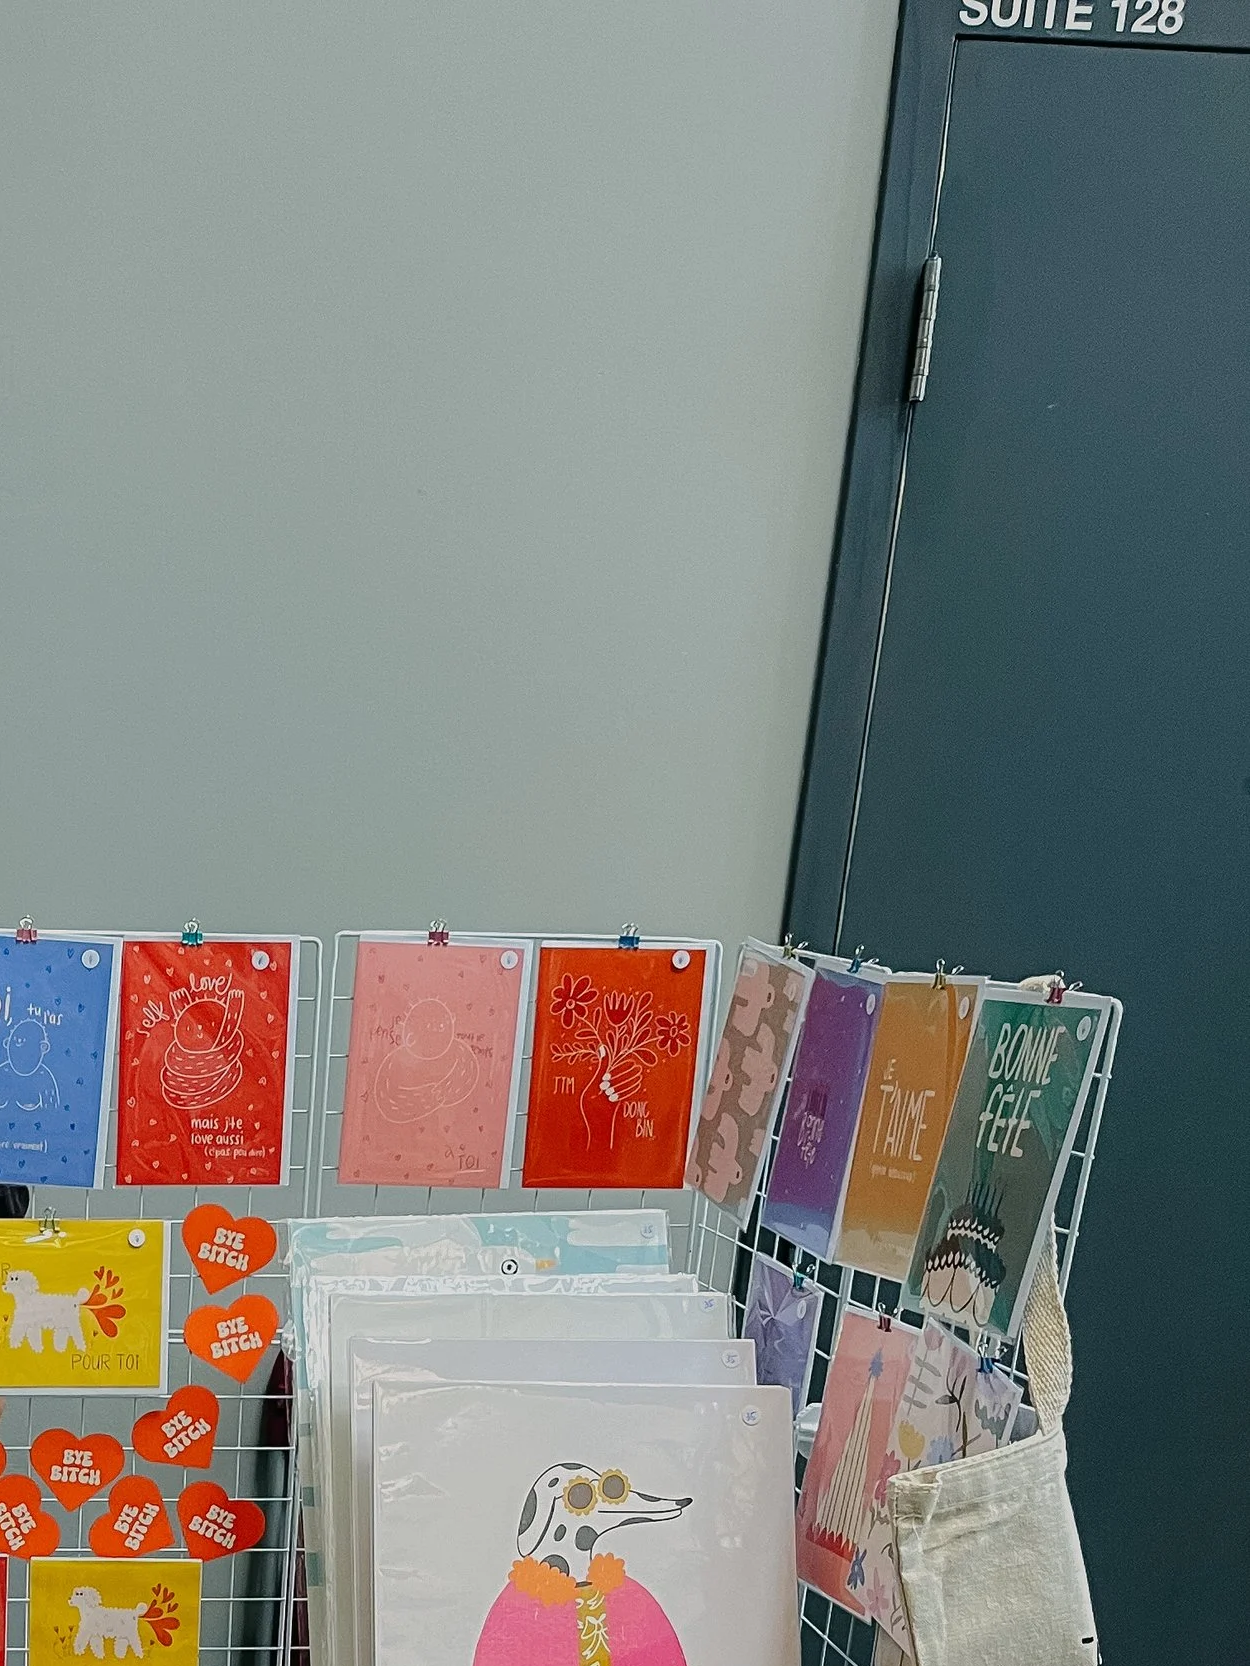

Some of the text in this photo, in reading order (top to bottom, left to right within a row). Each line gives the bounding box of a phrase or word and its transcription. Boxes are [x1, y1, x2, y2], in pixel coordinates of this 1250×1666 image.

[959, 0, 1184, 35] SUITE 128
[189, 973, 233, 996] love
[27, 1003, 41, 1017] tu
[988, 1022, 1067, 1086] BONNE
[191, 1114, 219, 1130] mais
[873, 1080, 936, 1161] T'AIME
[977, 1084, 1042, 1159] FÊTE
[191, 1130, 244, 1146] love aussi
[213, 1227, 246, 1250] BYE
[197, 1243, 249, 1271] BITCH
[216, 1316, 249, 1339] BYE
[210, 1331, 263, 1359] BITCH
[71, 1353, 110, 1371] POUR
[160, 1410, 193, 1437] BYE
[163, 1418, 212, 1458] BITCH
[62, 1449, 93, 1466] BYE
[50, 1465, 101, 1486] BITCH
[11, 1502, 37, 1535] BYE
[113, 1503, 139, 1534] BYE
[124, 1502, 160, 1551] BITCH
[205, 1504, 237, 1530] BYE
[187, 1515, 237, 1549] BITCH
